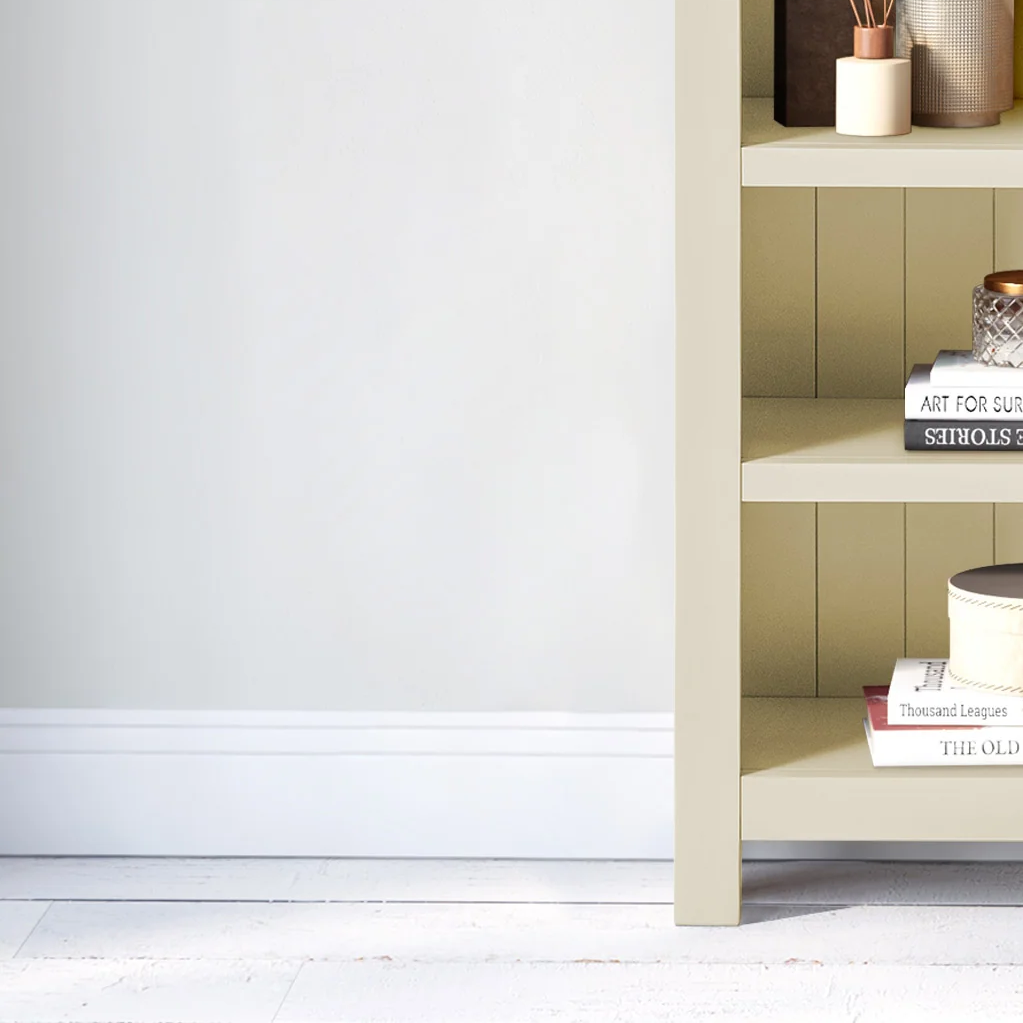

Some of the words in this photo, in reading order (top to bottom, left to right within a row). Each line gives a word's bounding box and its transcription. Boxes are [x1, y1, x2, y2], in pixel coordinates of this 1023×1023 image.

[921, 395, 949, 413] ART
[956, 395, 988, 413] FOR
[924, 427, 1011, 446] STORIES
[900, 703, 957, 717] Thousand
[960, 704, 1008, 720] Leagues
[940, 740, 977, 755] THE
[981, 739, 1020, 755] OLD
